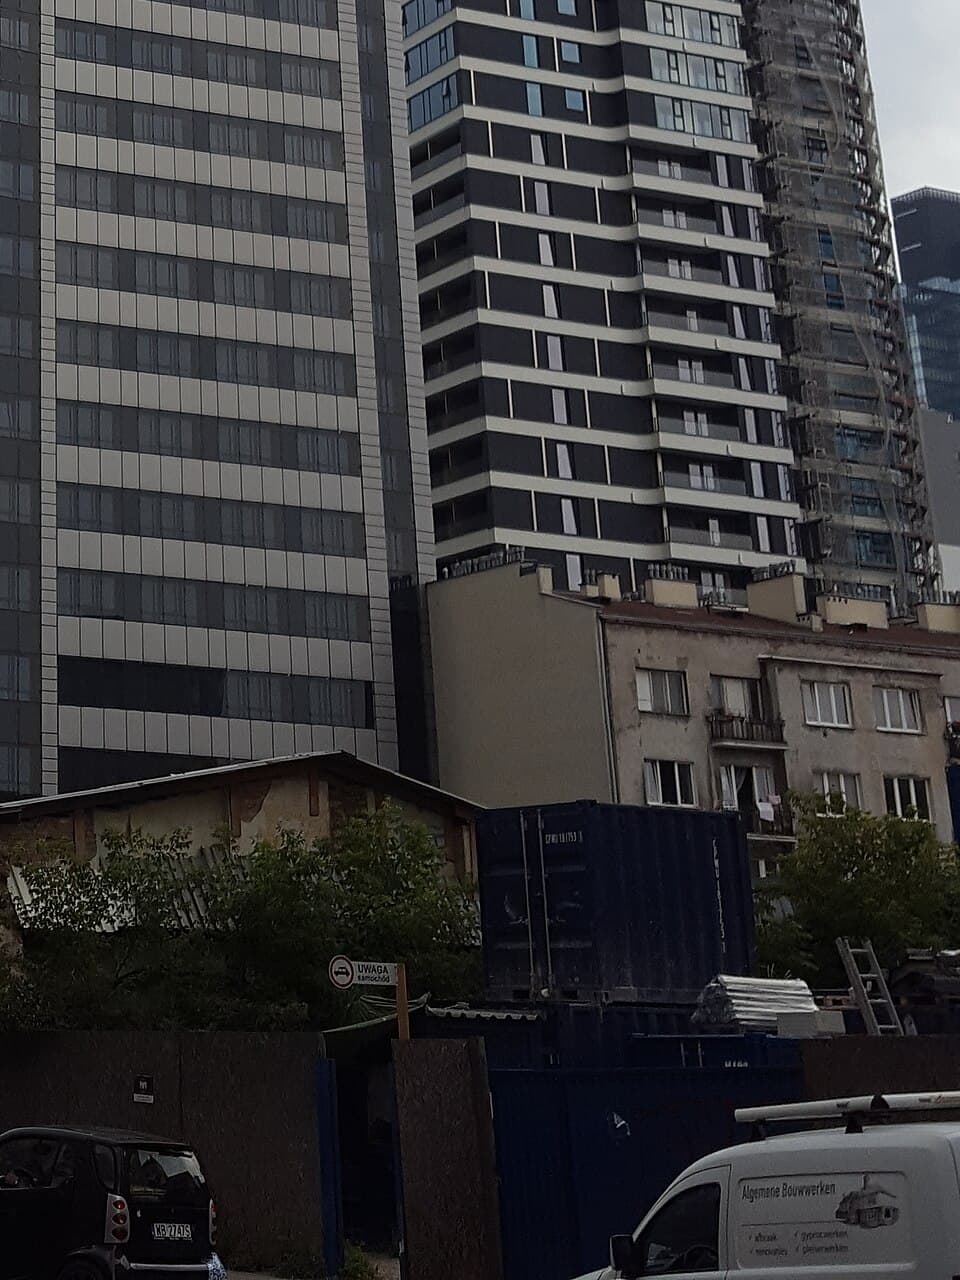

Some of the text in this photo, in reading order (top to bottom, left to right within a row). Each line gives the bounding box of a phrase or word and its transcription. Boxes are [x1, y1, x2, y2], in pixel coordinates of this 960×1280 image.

[357, 964, 389, 974] UWAGA
[742, 1180, 836, 1203] Algemene Bouwwerken
